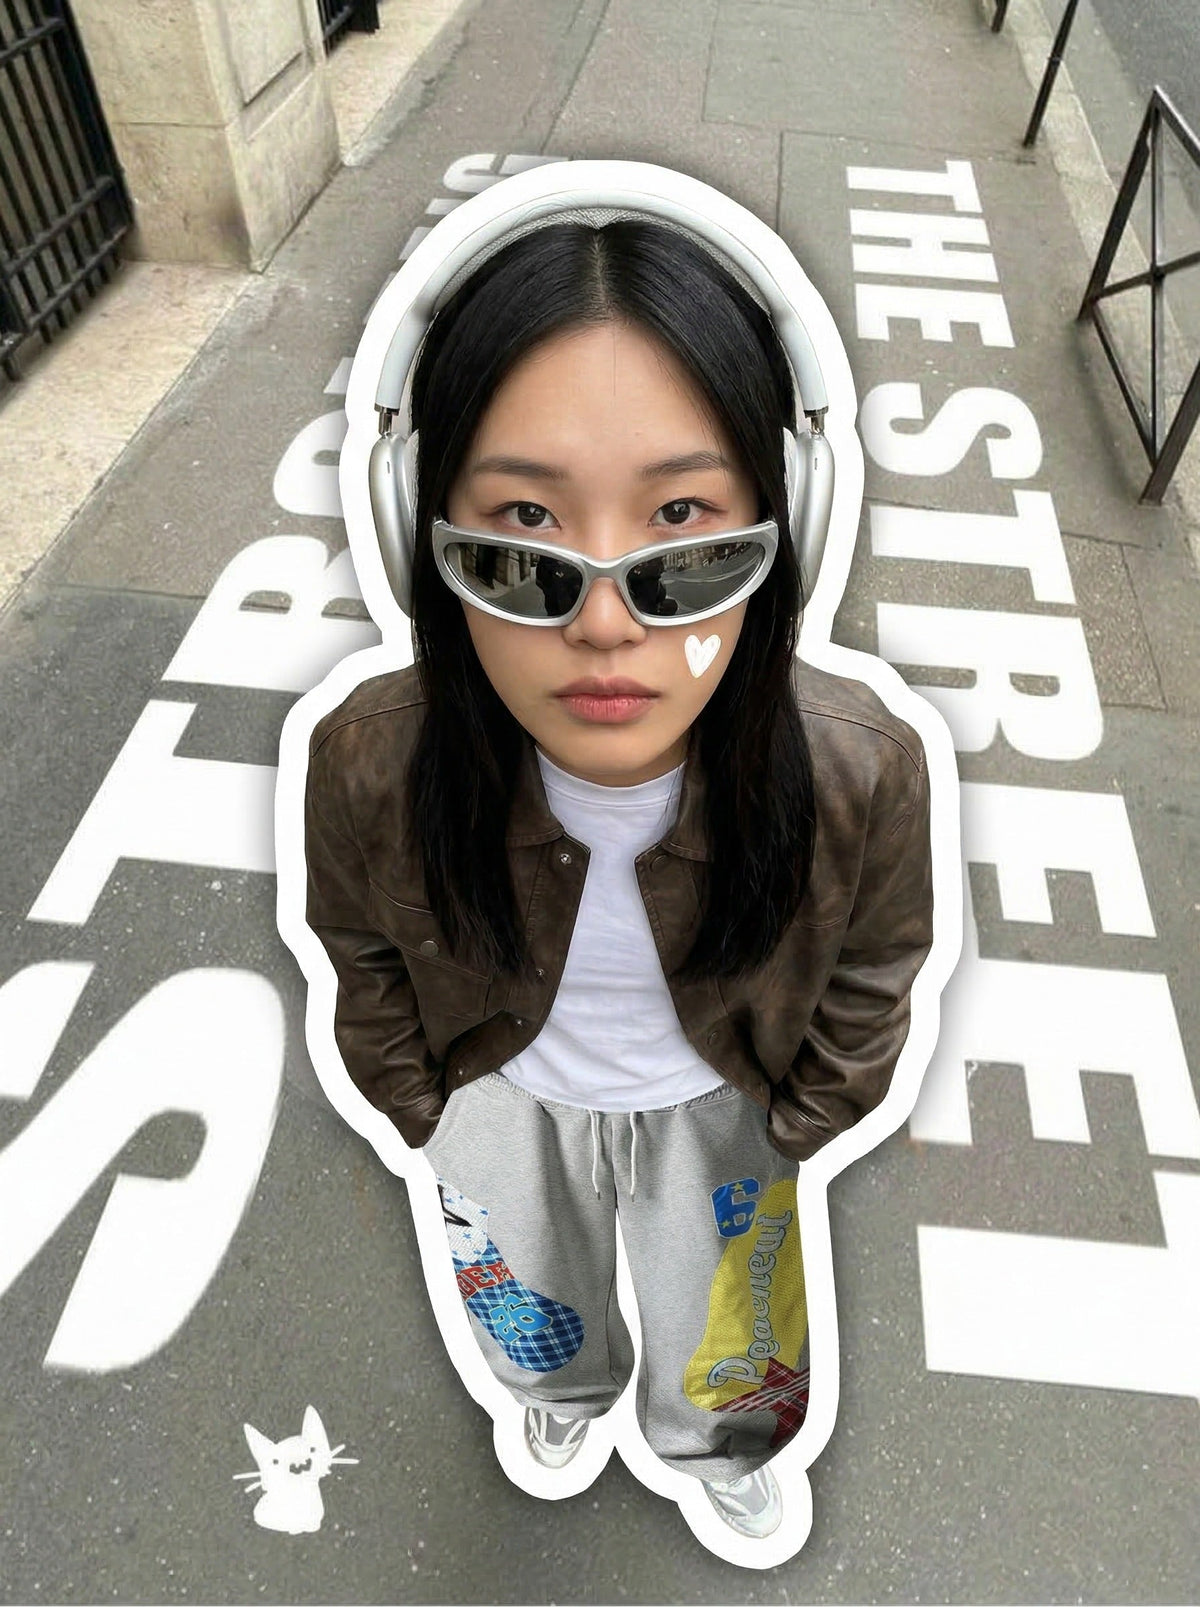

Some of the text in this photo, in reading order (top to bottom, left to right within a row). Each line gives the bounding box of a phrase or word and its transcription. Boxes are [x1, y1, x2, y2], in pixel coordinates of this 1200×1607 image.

[845, 160, 1200, 1398] THE STREET
[711, 1177, 760, 1238] 6
[489, 1292, 554, 1344] 26
